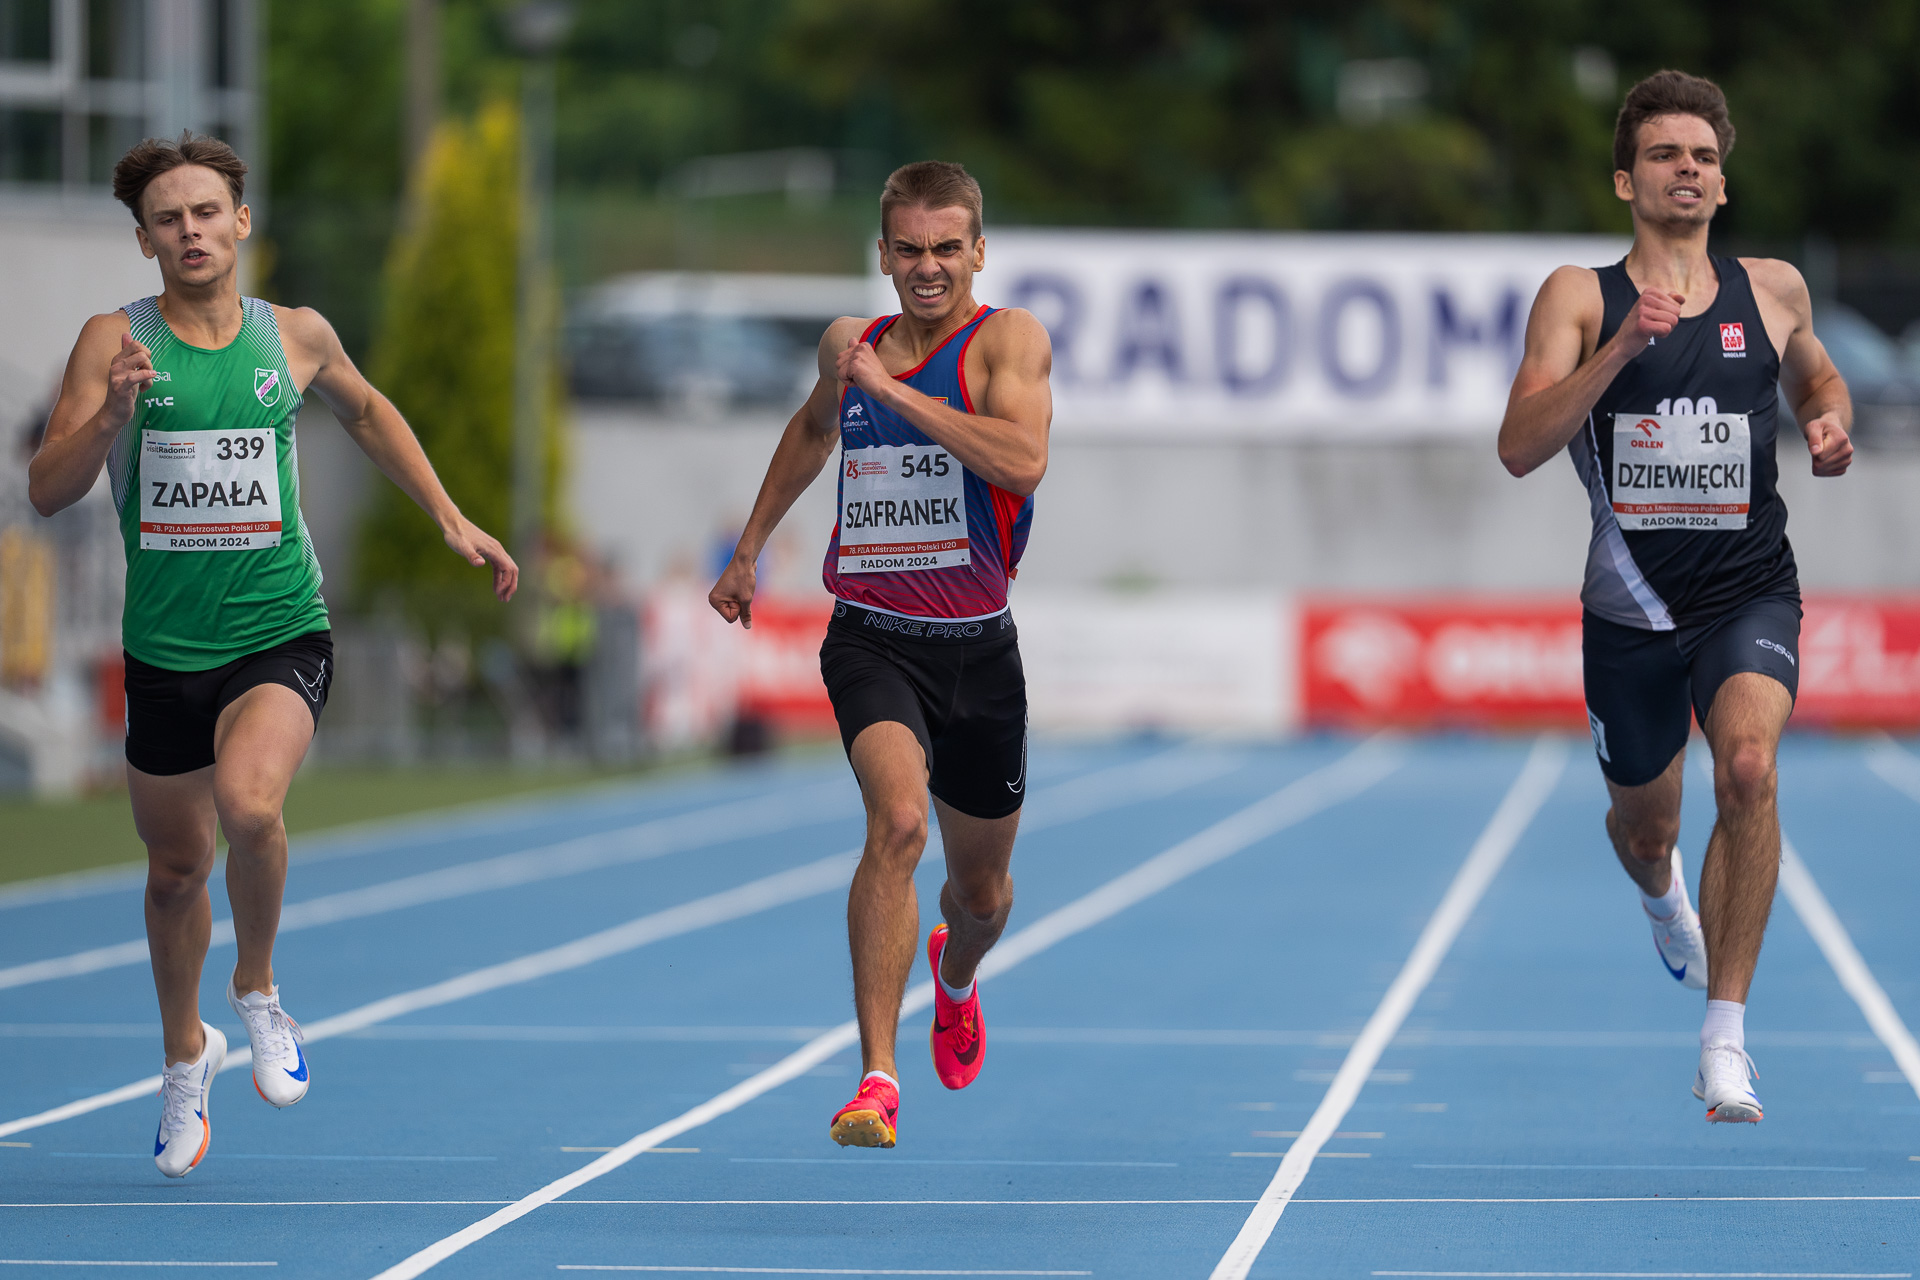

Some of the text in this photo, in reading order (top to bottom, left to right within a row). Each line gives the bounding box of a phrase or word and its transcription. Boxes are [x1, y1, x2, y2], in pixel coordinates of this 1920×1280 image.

[1012, 273, 1524, 390] RADOM
[1699, 422, 1730, 444] 10
[146, 445, 196, 455] visitRadom.pl
[216, 437, 265, 460] 339
[1630, 439, 1664, 449] ORLEN
[900, 453, 950, 479] 545
[1618, 462, 1744, 494] DZIEWIĘCKI
[152, 480, 268, 508] ZAPAŁA
[845, 497, 961, 529] SZAFRANEK
[1654, 504, 1699, 512] Mistrzostwa
[164, 525, 181, 533] PZLA
[183, 525, 230, 533] Mistrzostwa
[231, 523, 253, 532] Polski
[1641, 516, 1718, 527] RADOM 2024
[170, 537, 250, 548] RADOM 2024
[857, 546, 870, 554] PZLA
[871, 544, 916, 553] Mistrzostwa
[917, 542, 940, 552] Polski
[941, 541, 957, 549] U20
[860, 556, 938, 569] RADOM 2024
[864, 612, 983, 638] NIKE PRO
